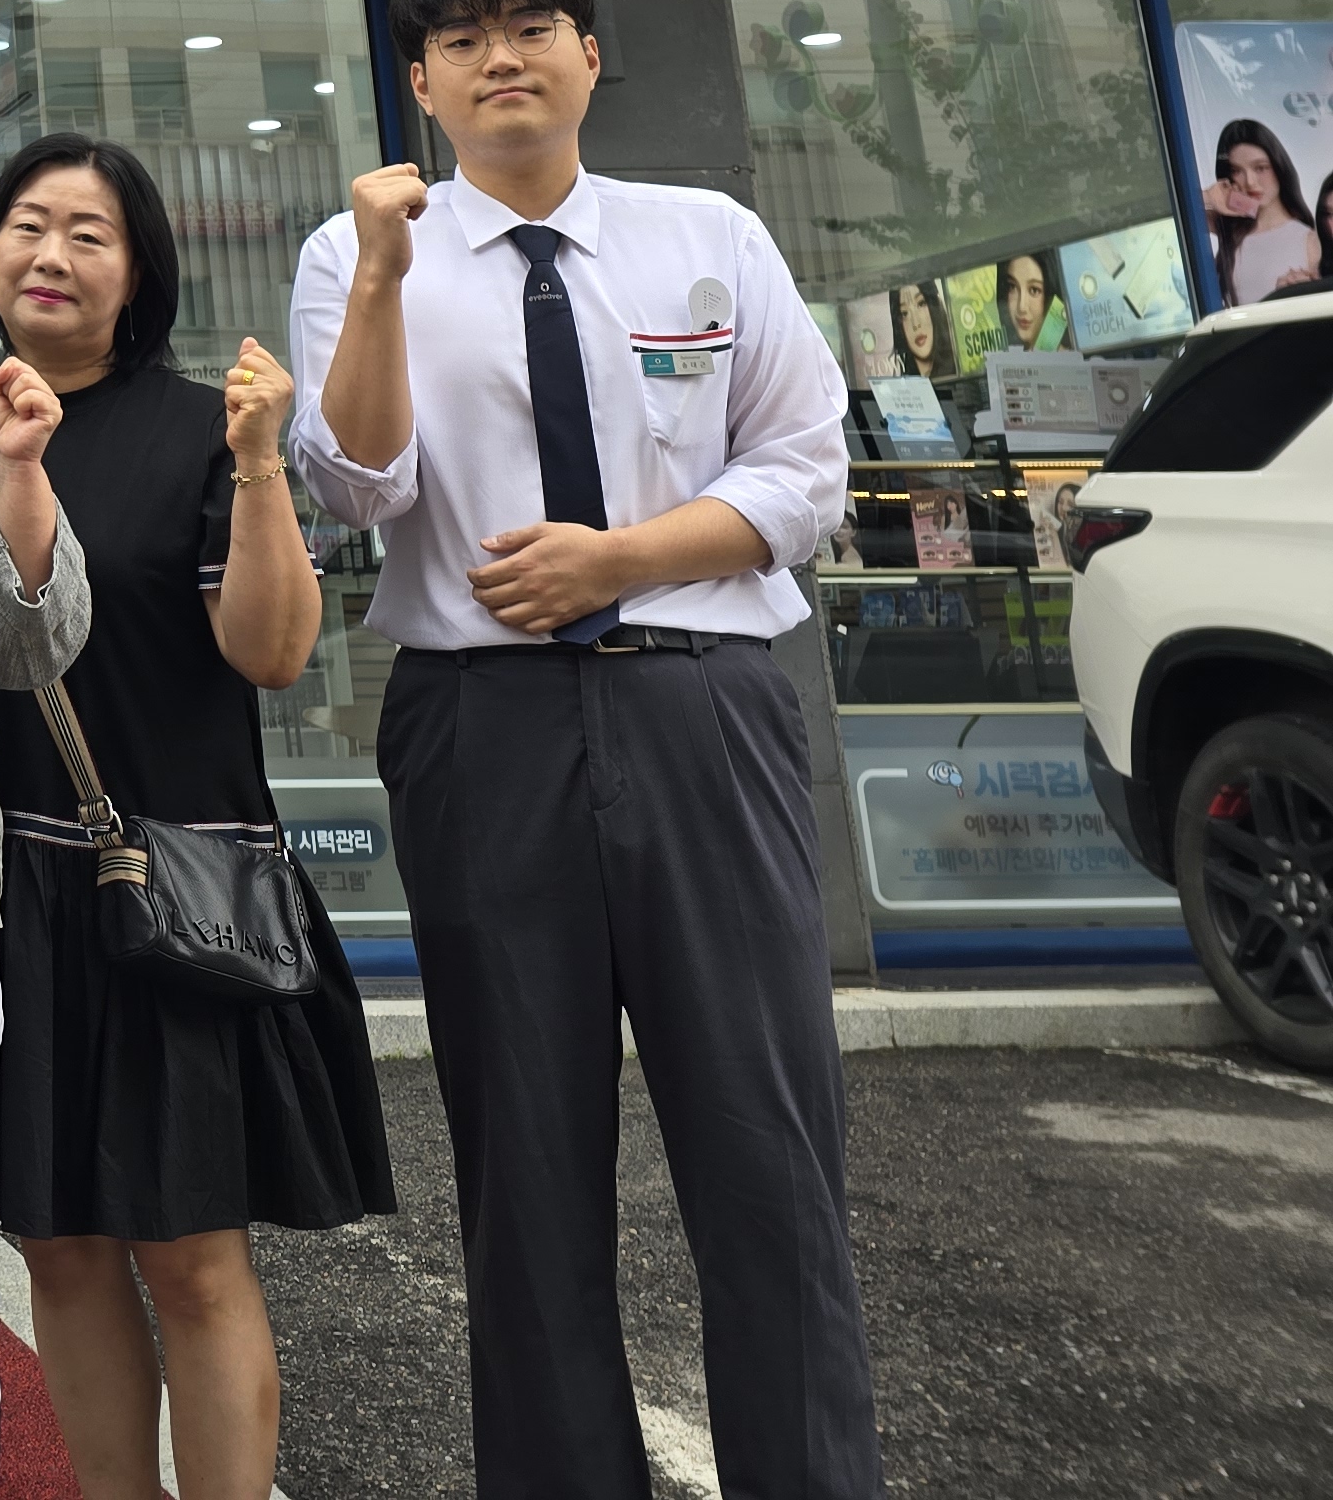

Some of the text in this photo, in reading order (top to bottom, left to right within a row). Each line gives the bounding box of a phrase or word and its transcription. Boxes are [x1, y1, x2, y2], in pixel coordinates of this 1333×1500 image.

[1083, 301, 1113, 319] SHINE
[1085, 318, 1126, 337] TOUCH
[975, 760, 1094, 798] 시력검
[299, 829, 373, 854] 시력관리
[313, 870, 372, 892] 로그램"
